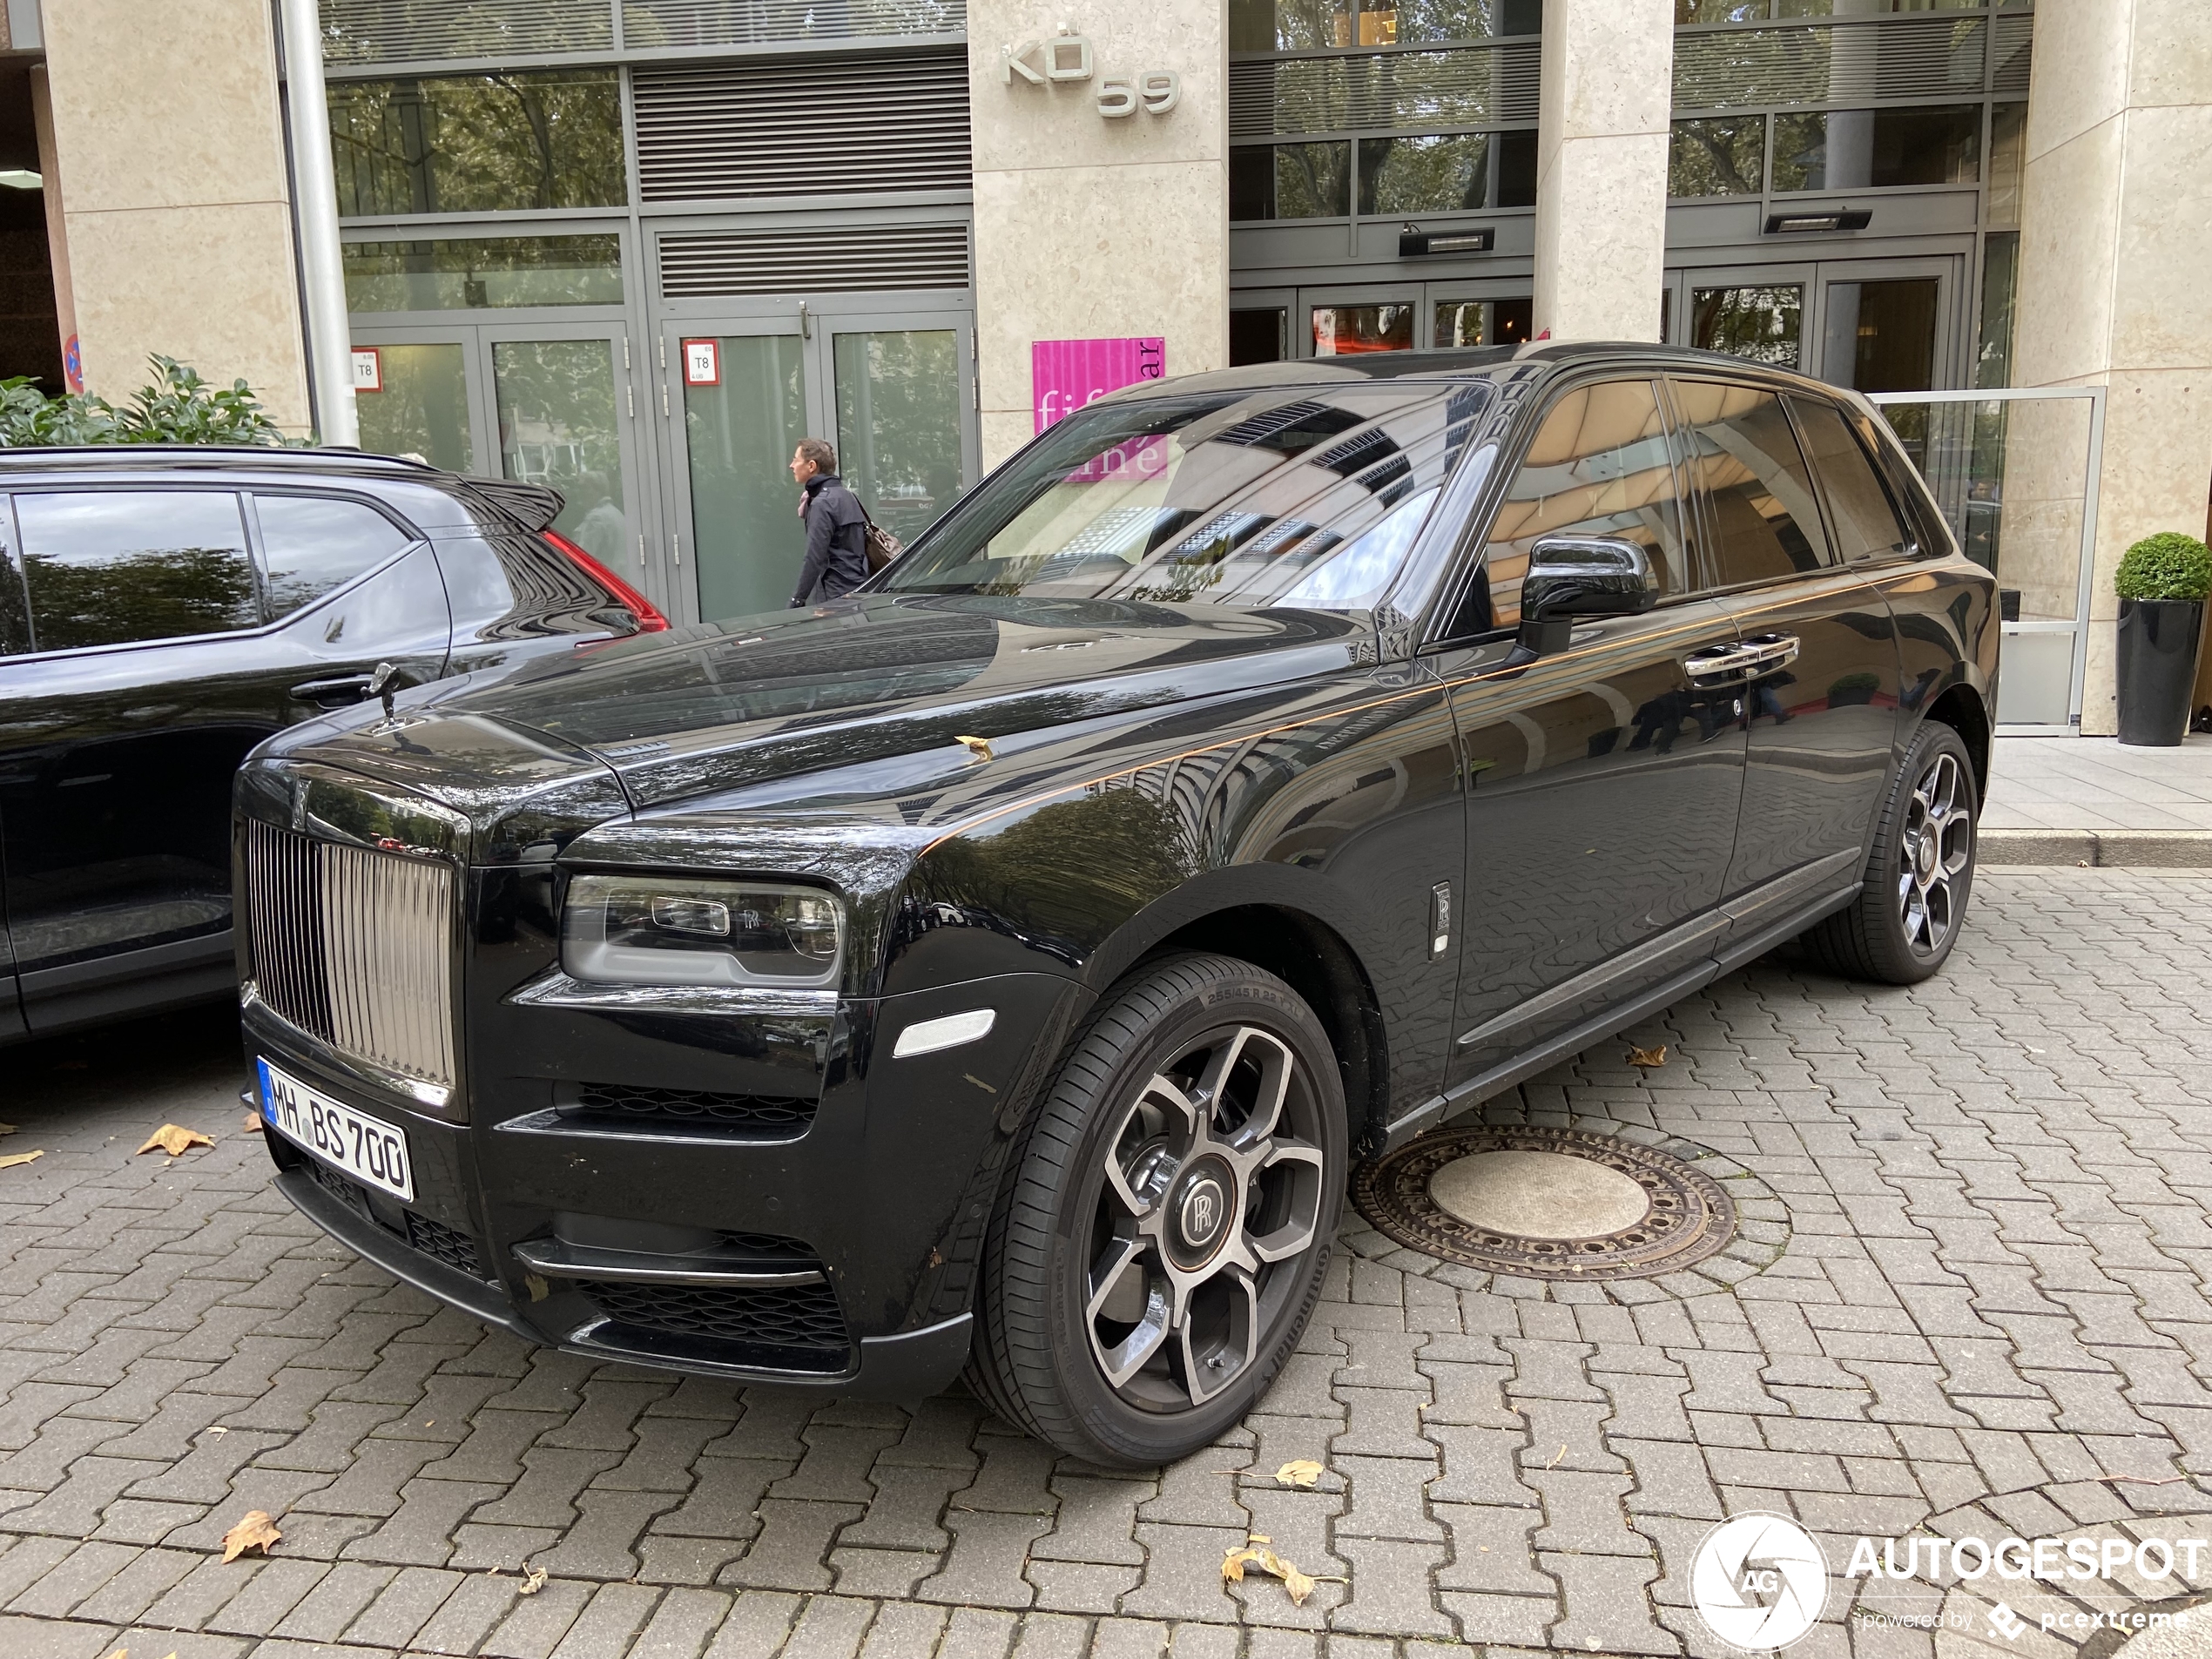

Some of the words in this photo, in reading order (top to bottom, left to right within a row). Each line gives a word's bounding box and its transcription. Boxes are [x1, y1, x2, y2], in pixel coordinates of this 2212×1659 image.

[1001, 21, 1093, 84] KÖ
[1096, 69, 1181, 118] 59
[358, 364, 372, 376] T8
[694, 357, 709, 369] T8
[1207, 988, 1251, 1005] 255/45
[1252, 988, 1260, 999] R
[1263, 990, 1277, 1003] 22
[270, 1074, 300, 1135] MH
[1271, 1243, 1332, 1372] Continental
